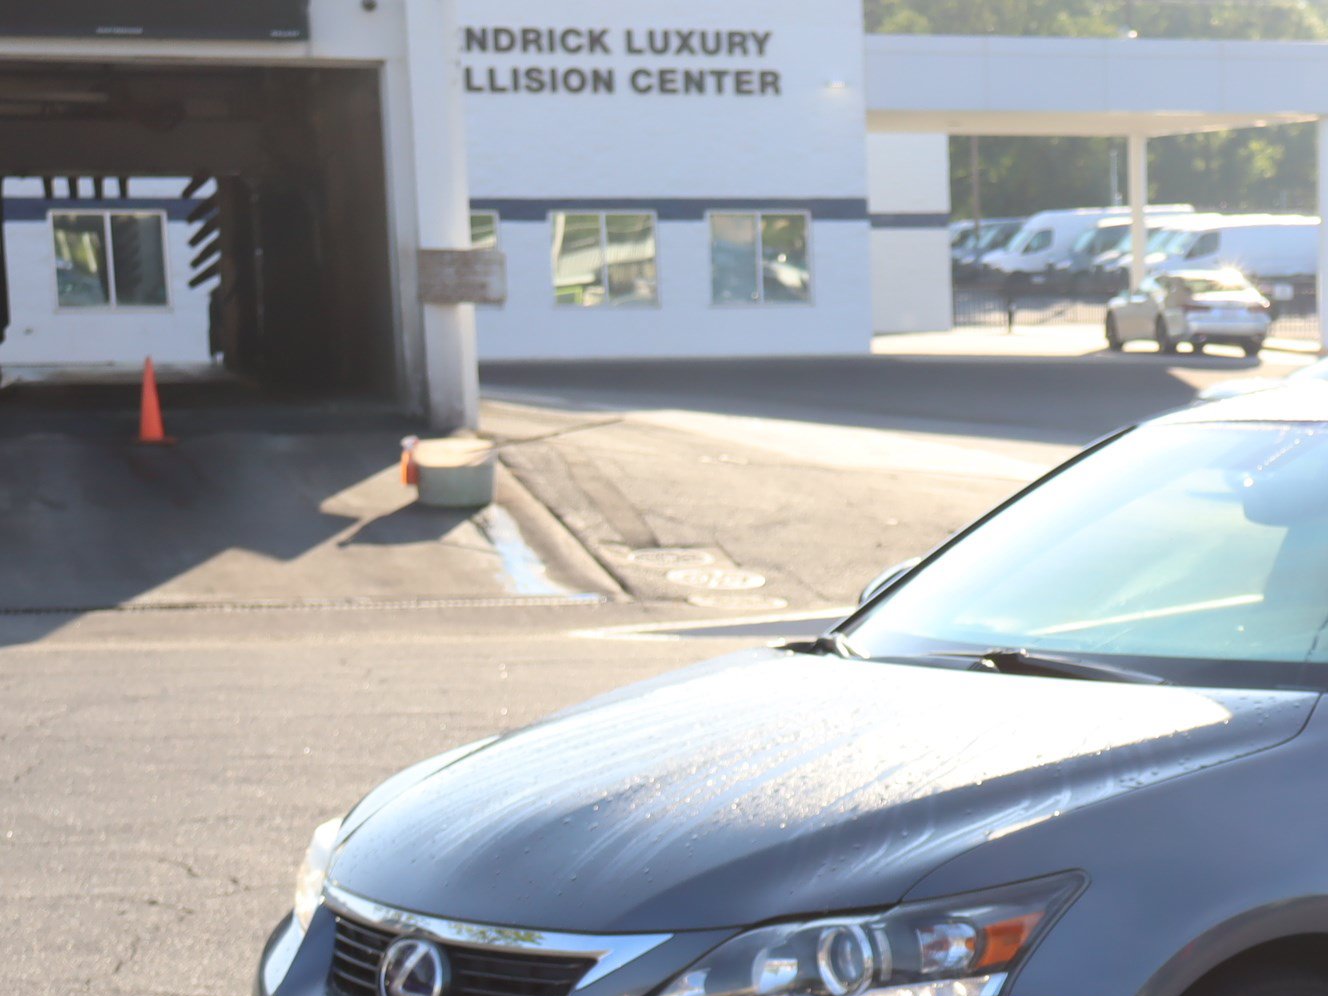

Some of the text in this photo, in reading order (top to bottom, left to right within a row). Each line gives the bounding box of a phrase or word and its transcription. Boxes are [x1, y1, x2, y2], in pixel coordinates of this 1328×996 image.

[461, 27, 772, 56] NDRICK LUXURY
[464, 67, 782, 95] LLISION CENTER
